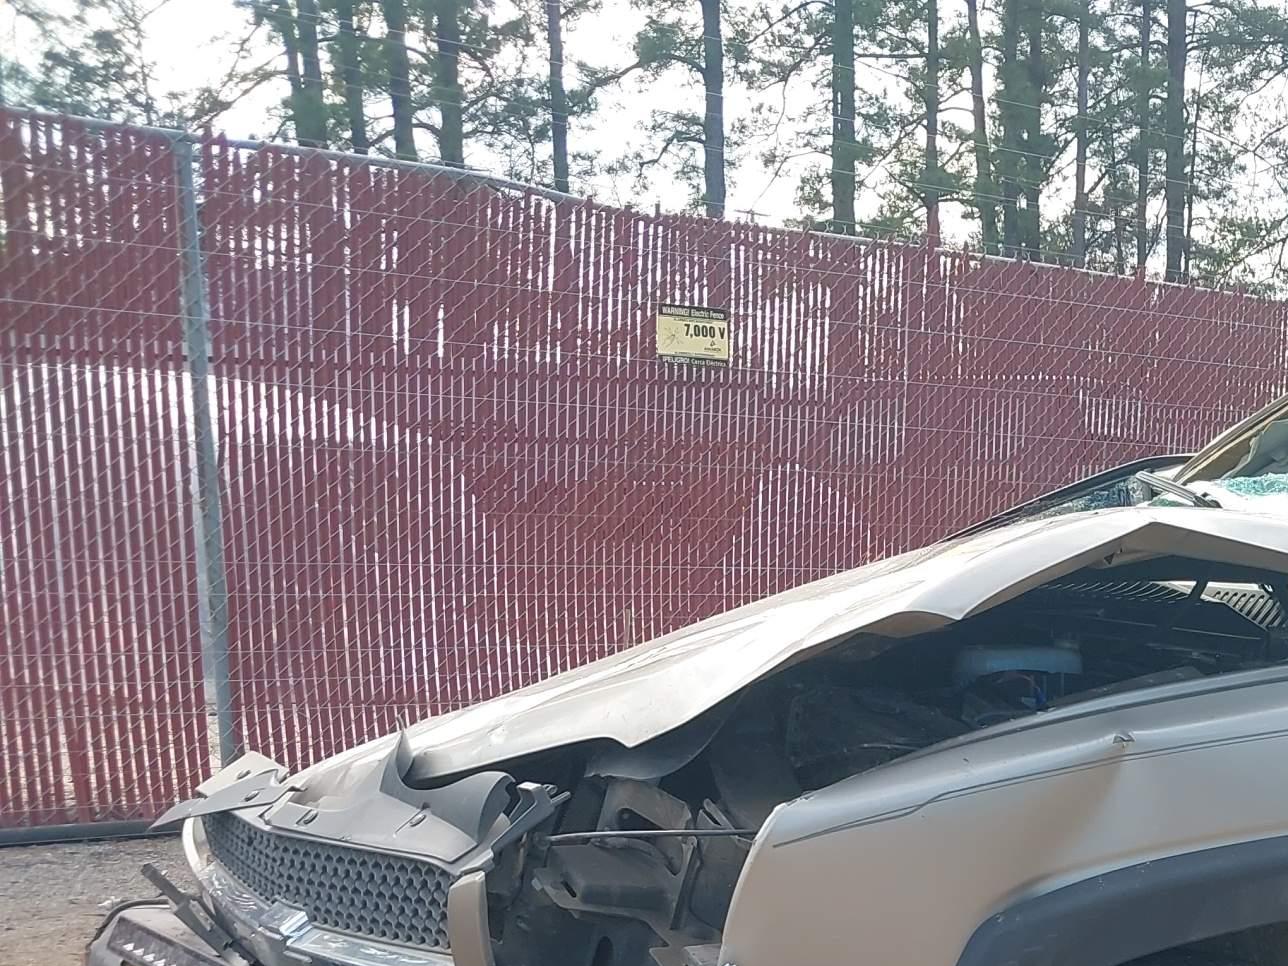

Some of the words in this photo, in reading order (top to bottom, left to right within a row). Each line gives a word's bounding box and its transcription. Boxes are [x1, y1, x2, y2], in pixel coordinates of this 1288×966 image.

[691, 309, 709, 317] Electric
[710, 311, 725, 319] Fence
[684, 323, 716, 339] 7,000
[719, 327, 725, 339] V
